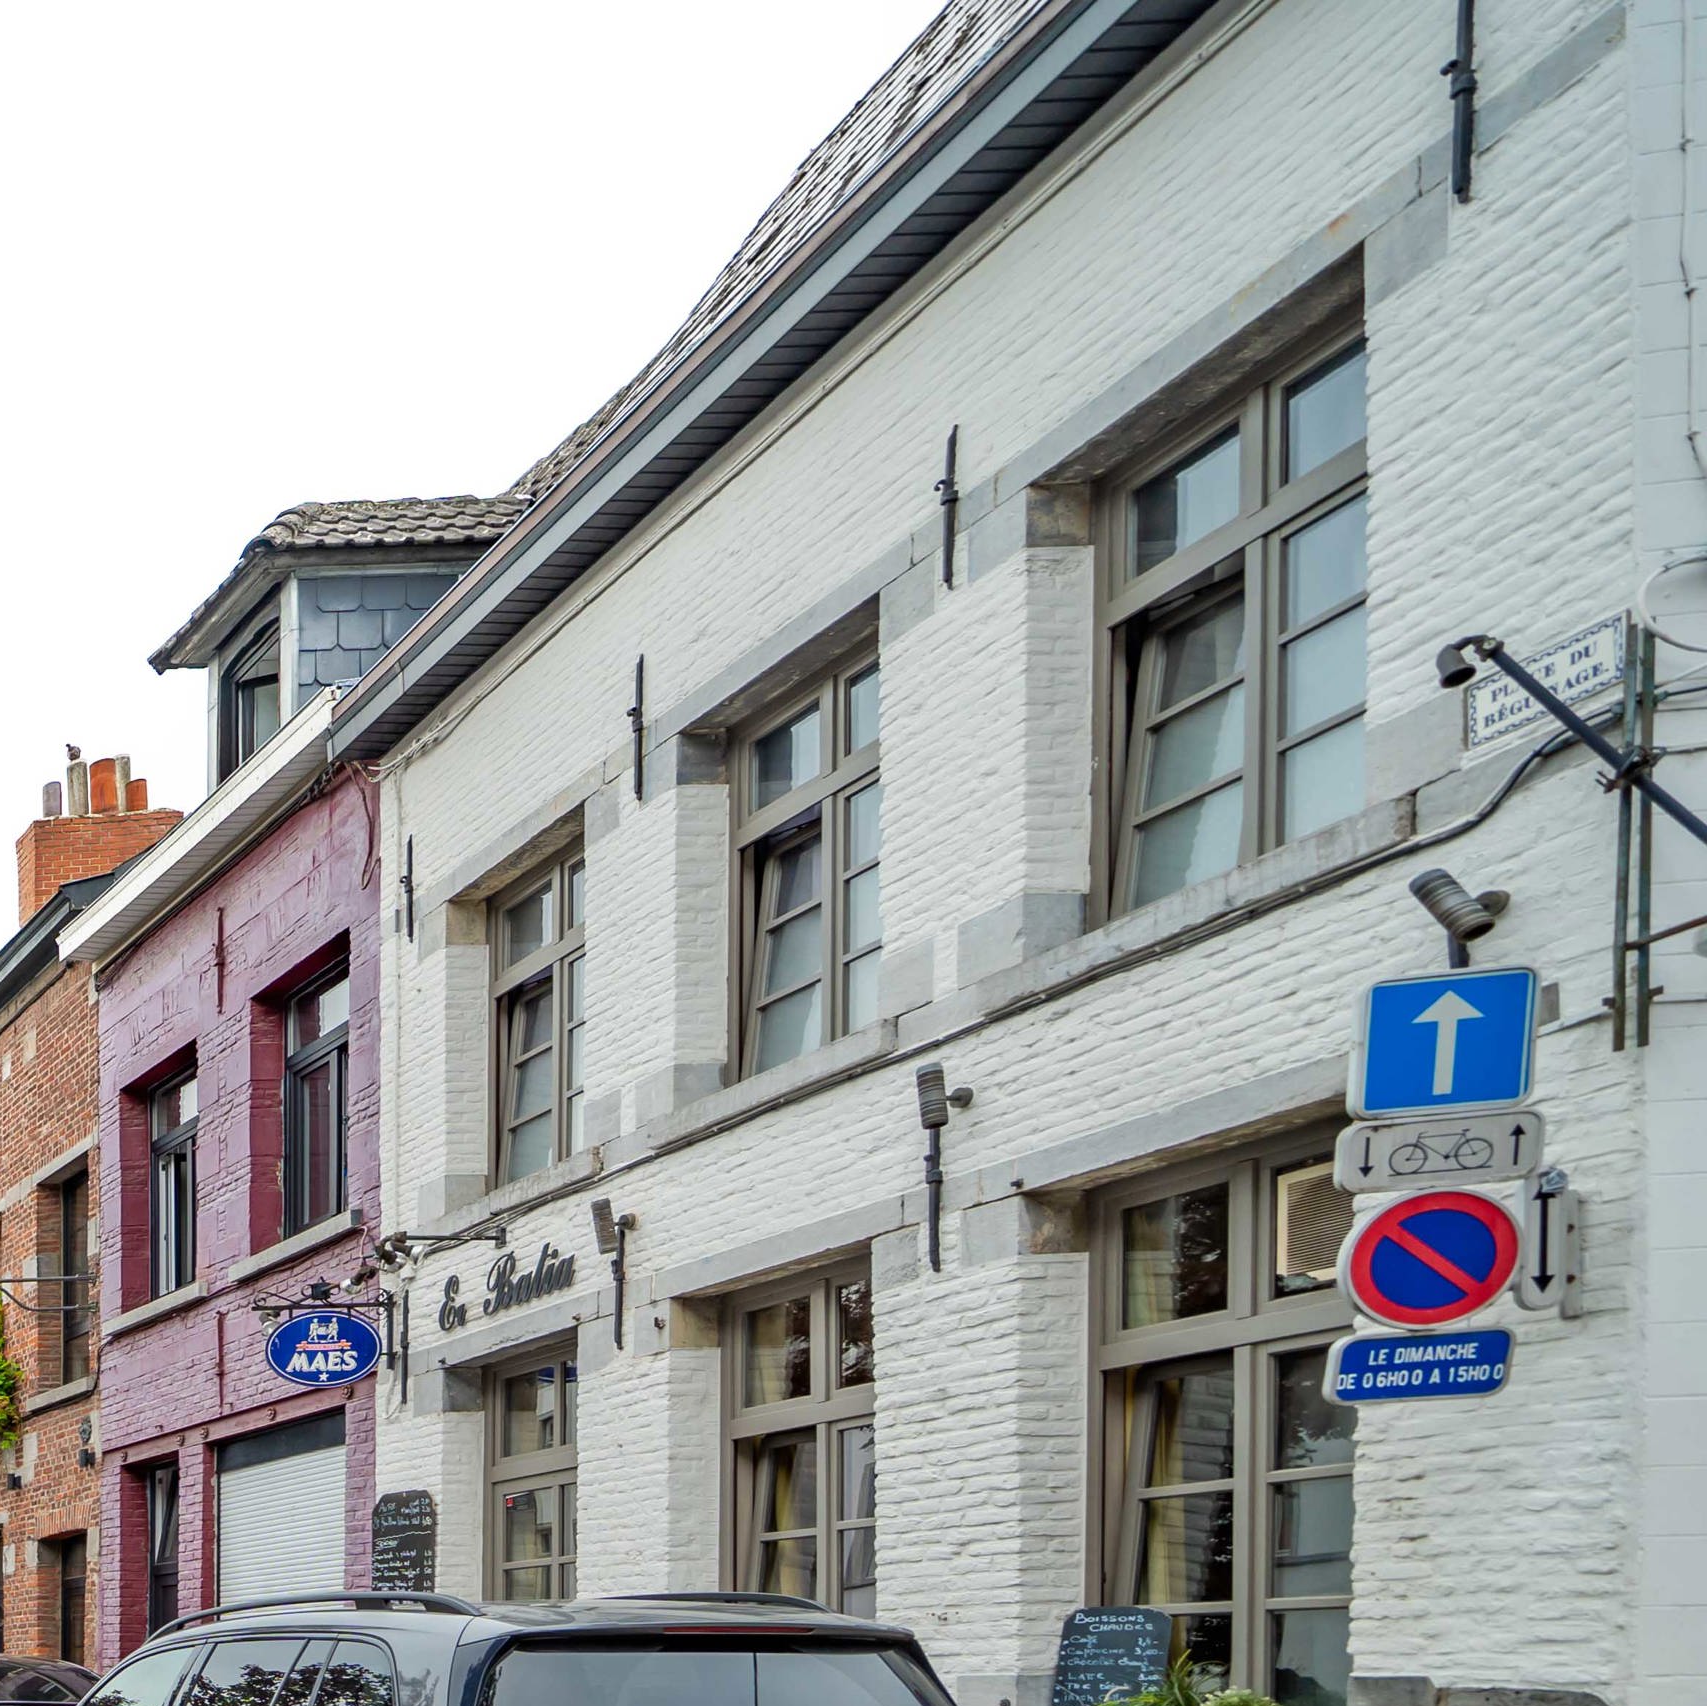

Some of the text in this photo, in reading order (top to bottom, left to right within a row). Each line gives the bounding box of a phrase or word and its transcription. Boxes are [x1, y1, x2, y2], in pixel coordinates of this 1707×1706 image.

[1491, 640, 1598, 703] PLCE DU
[1483, 661, 1610, 729] BÉGUNAGE.
[285, 1351, 358, 1372] MAES
[1368, 1343, 1479, 1366] LE DIMANCHE
[1337, 1373, 1357, 1391] DE
[1362, 1368, 1423, 1389] 06H00
[1448, 1364, 1505, 1384] 15H00
